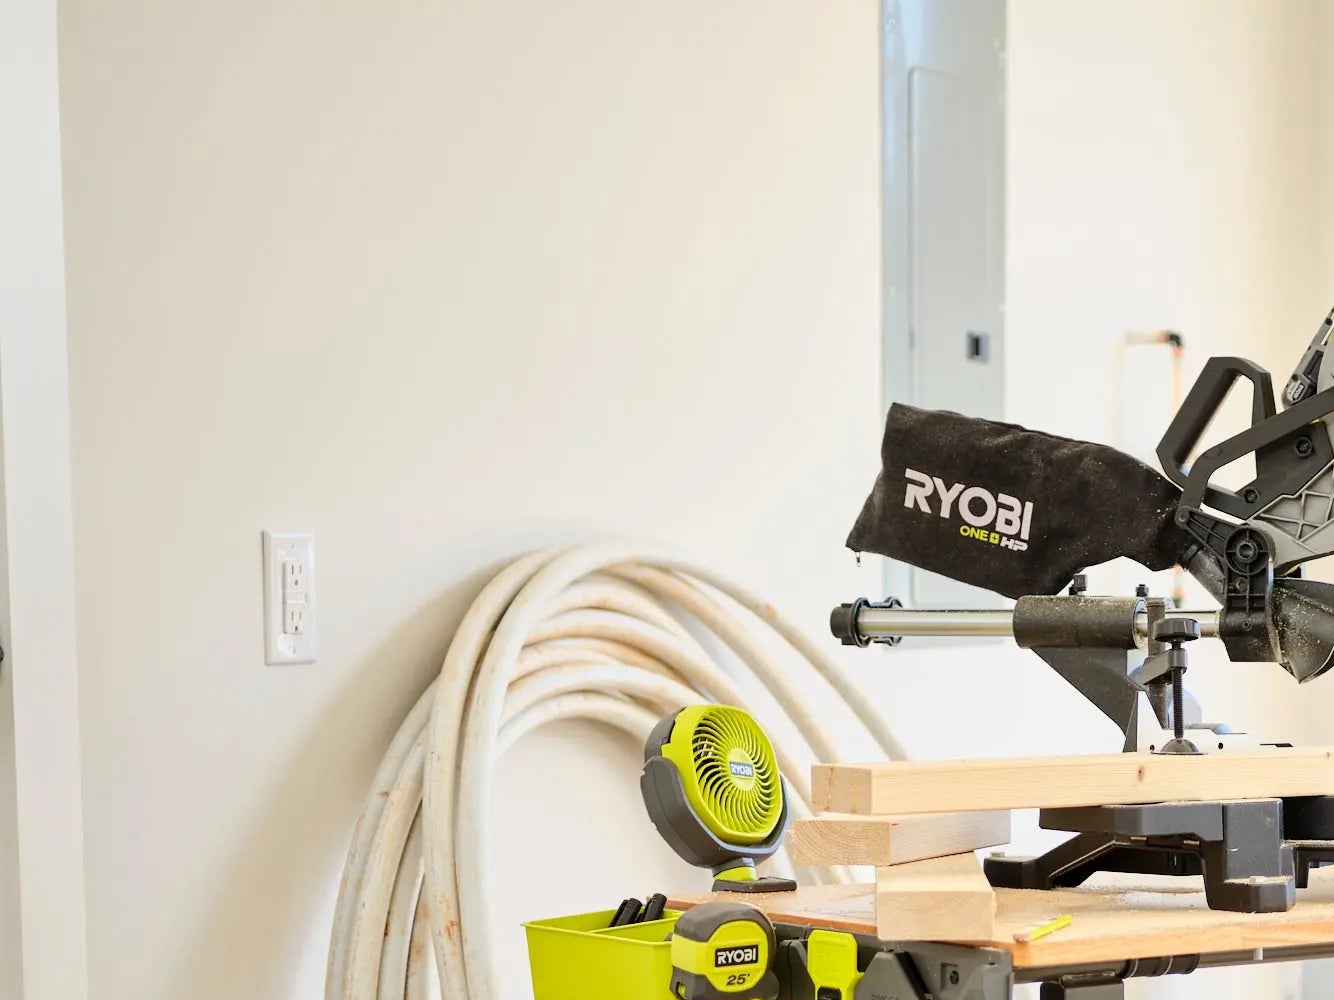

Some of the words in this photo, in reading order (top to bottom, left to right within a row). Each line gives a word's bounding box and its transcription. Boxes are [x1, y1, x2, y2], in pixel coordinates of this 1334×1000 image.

[904, 468, 1034, 540] RYOBI
[1000, 536, 1029, 551] HP
[716, 947, 757, 965] RYOBI
